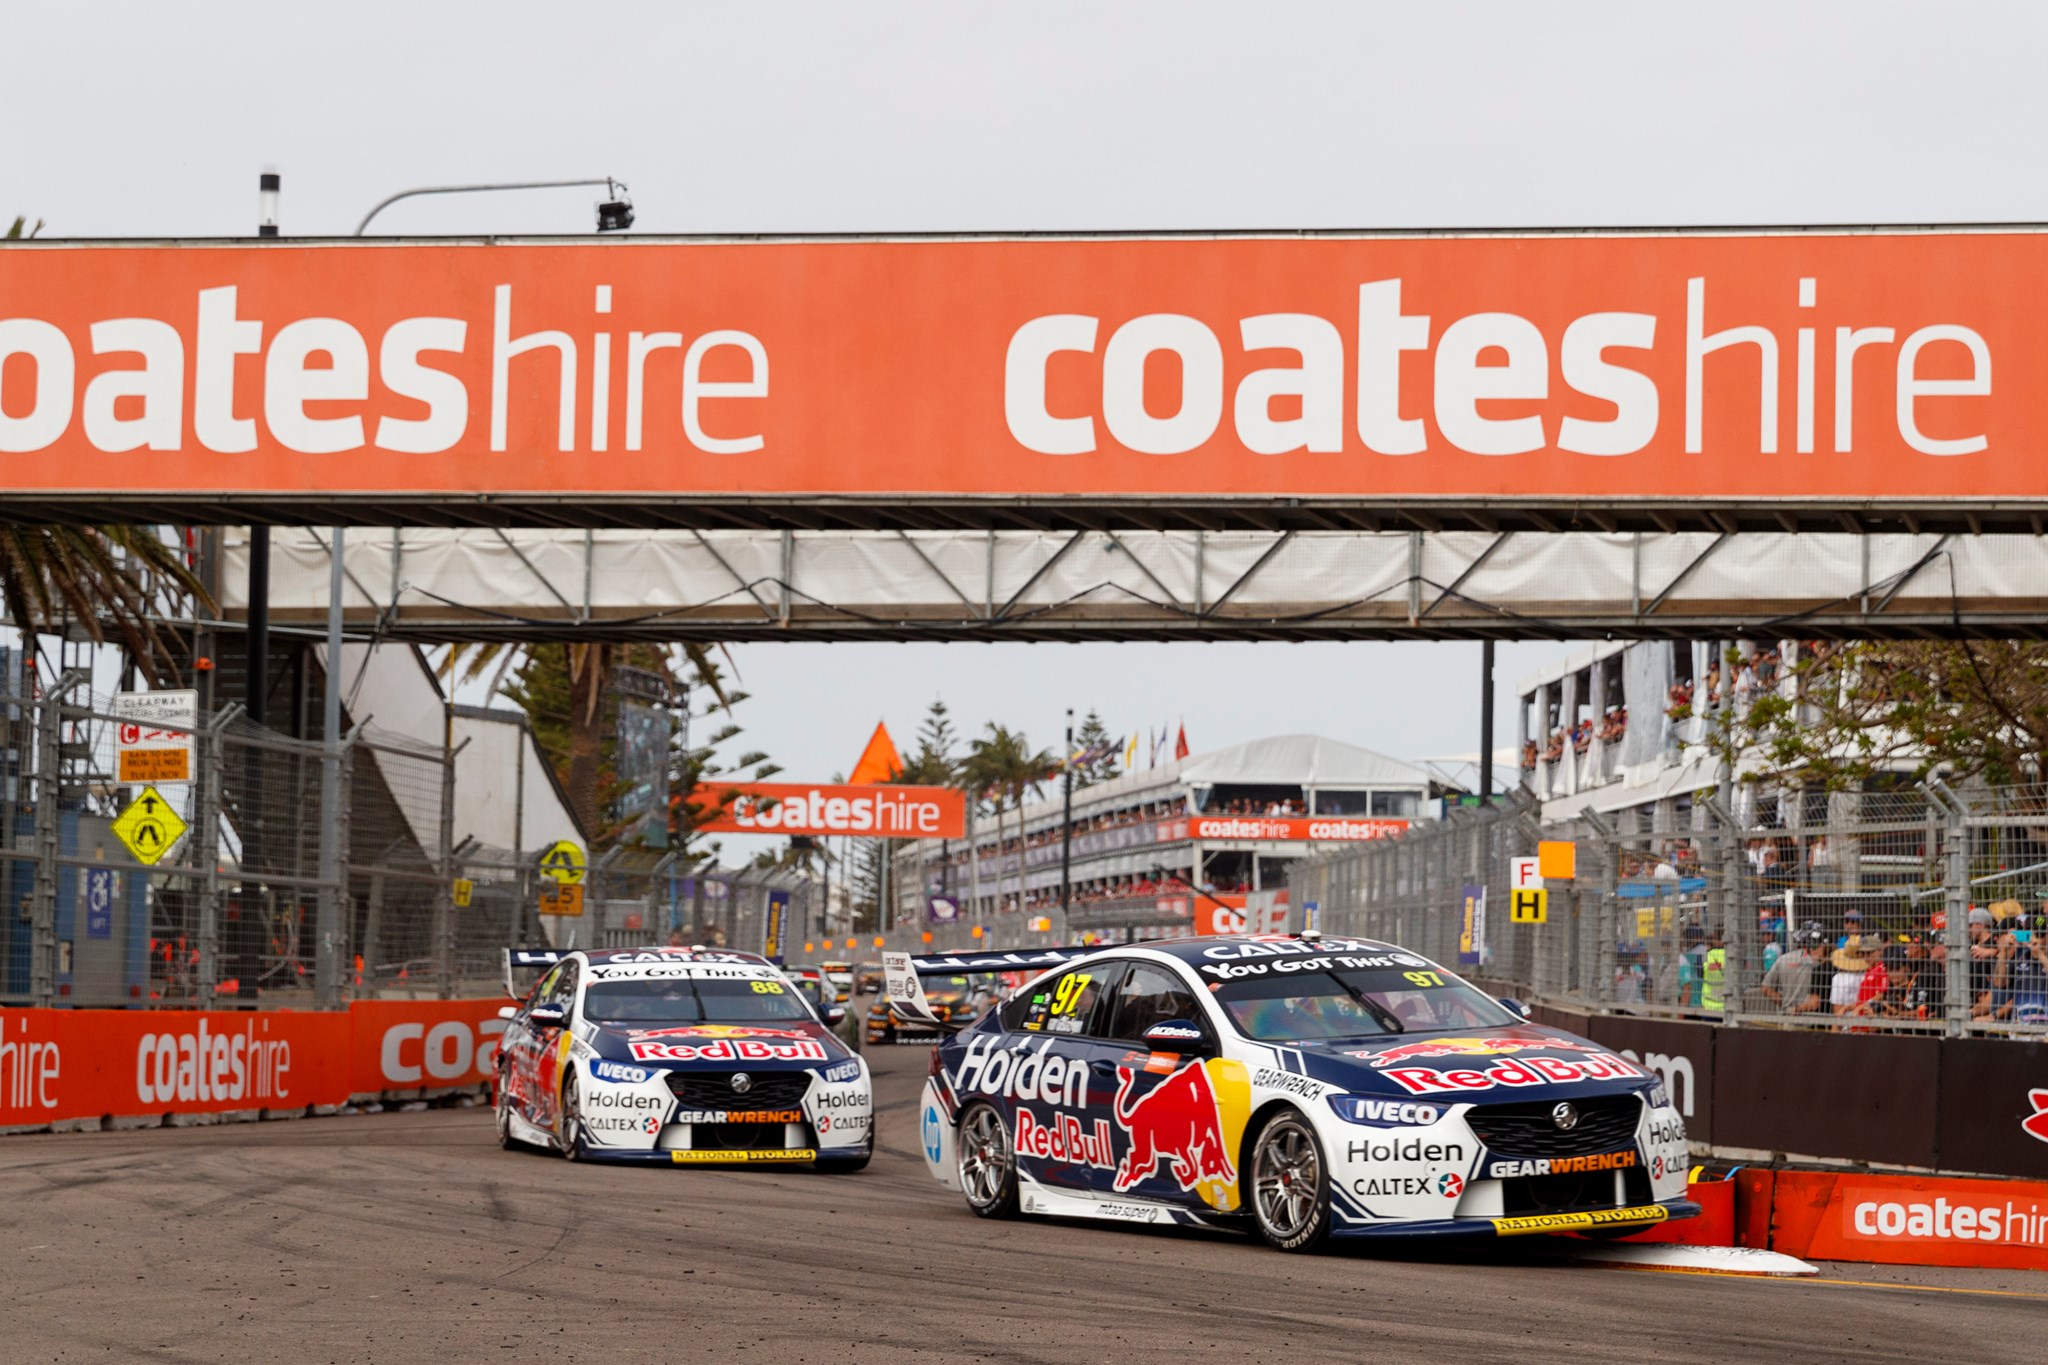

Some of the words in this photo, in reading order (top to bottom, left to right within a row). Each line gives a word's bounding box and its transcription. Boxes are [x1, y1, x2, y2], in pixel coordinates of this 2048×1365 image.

[1521, 863, 1534, 885] F
[1517, 892, 1539, 919] H
[750, 981, 785, 995] 88
[1403, 971, 1446, 987] 97
[1051, 973, 1093, 1016] 97
[596, 1062, 647, 1083] IVECO
[825, 1062, 860, 1082] IVECO
[954, 1034, 1090, 1109] Holden
[1253, 1067, 1325, 1101] GEARWRENCH
[588, 1091, 661, 1109] Holden
[679, 1111, 801, 1124] GEARWRENCH
[1355, 1101, 1438, 1125] IVECO
[590, 1117, 638, 1131] CALTEX
[676, 1150, 744, 1160] NATIONAL
[748, 1149, 813, 1161] STORAGE
[1348, 1138, 1463, 1163] Holden
[1489, 1150, 1636, 1178] GEARWRENCH
[1353, 1178, 1431, 1196] CALTEX
[1500, 1212, 1588, 1231] NATIONAL
[1593, 1206, 1664, 1224] STORAGE
